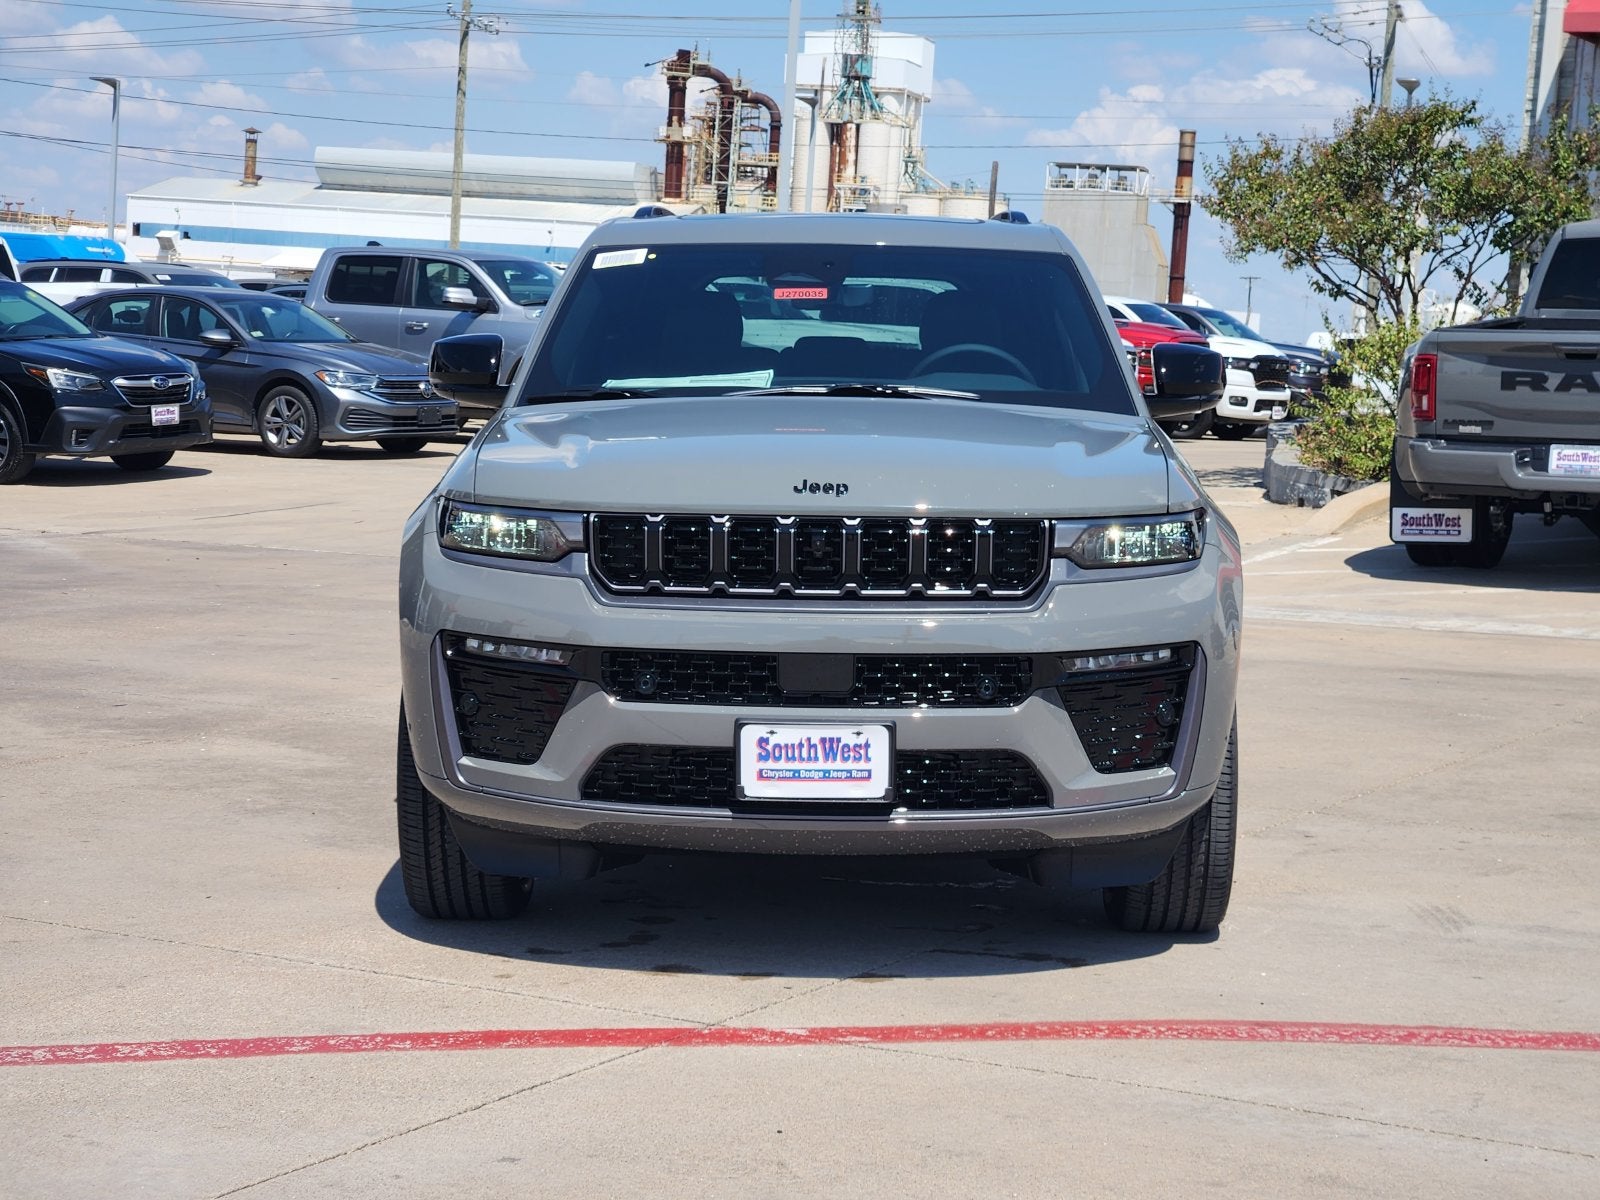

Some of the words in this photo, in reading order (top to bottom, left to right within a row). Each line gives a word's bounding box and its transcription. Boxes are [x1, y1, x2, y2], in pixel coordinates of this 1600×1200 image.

[778, 290, 824, 298] J270035
[793, 479, 849, 498] Jeep
[1401, 512, 1462, 528] SouthWest
[756, 736, 872, 764] SouthWest
[762, 769, 794, 779] Chrysler
[800, 769, 824, 779] Dodge
[829, 769, 848, 780] Jeep
[851, 769, 869, 778] Ram
